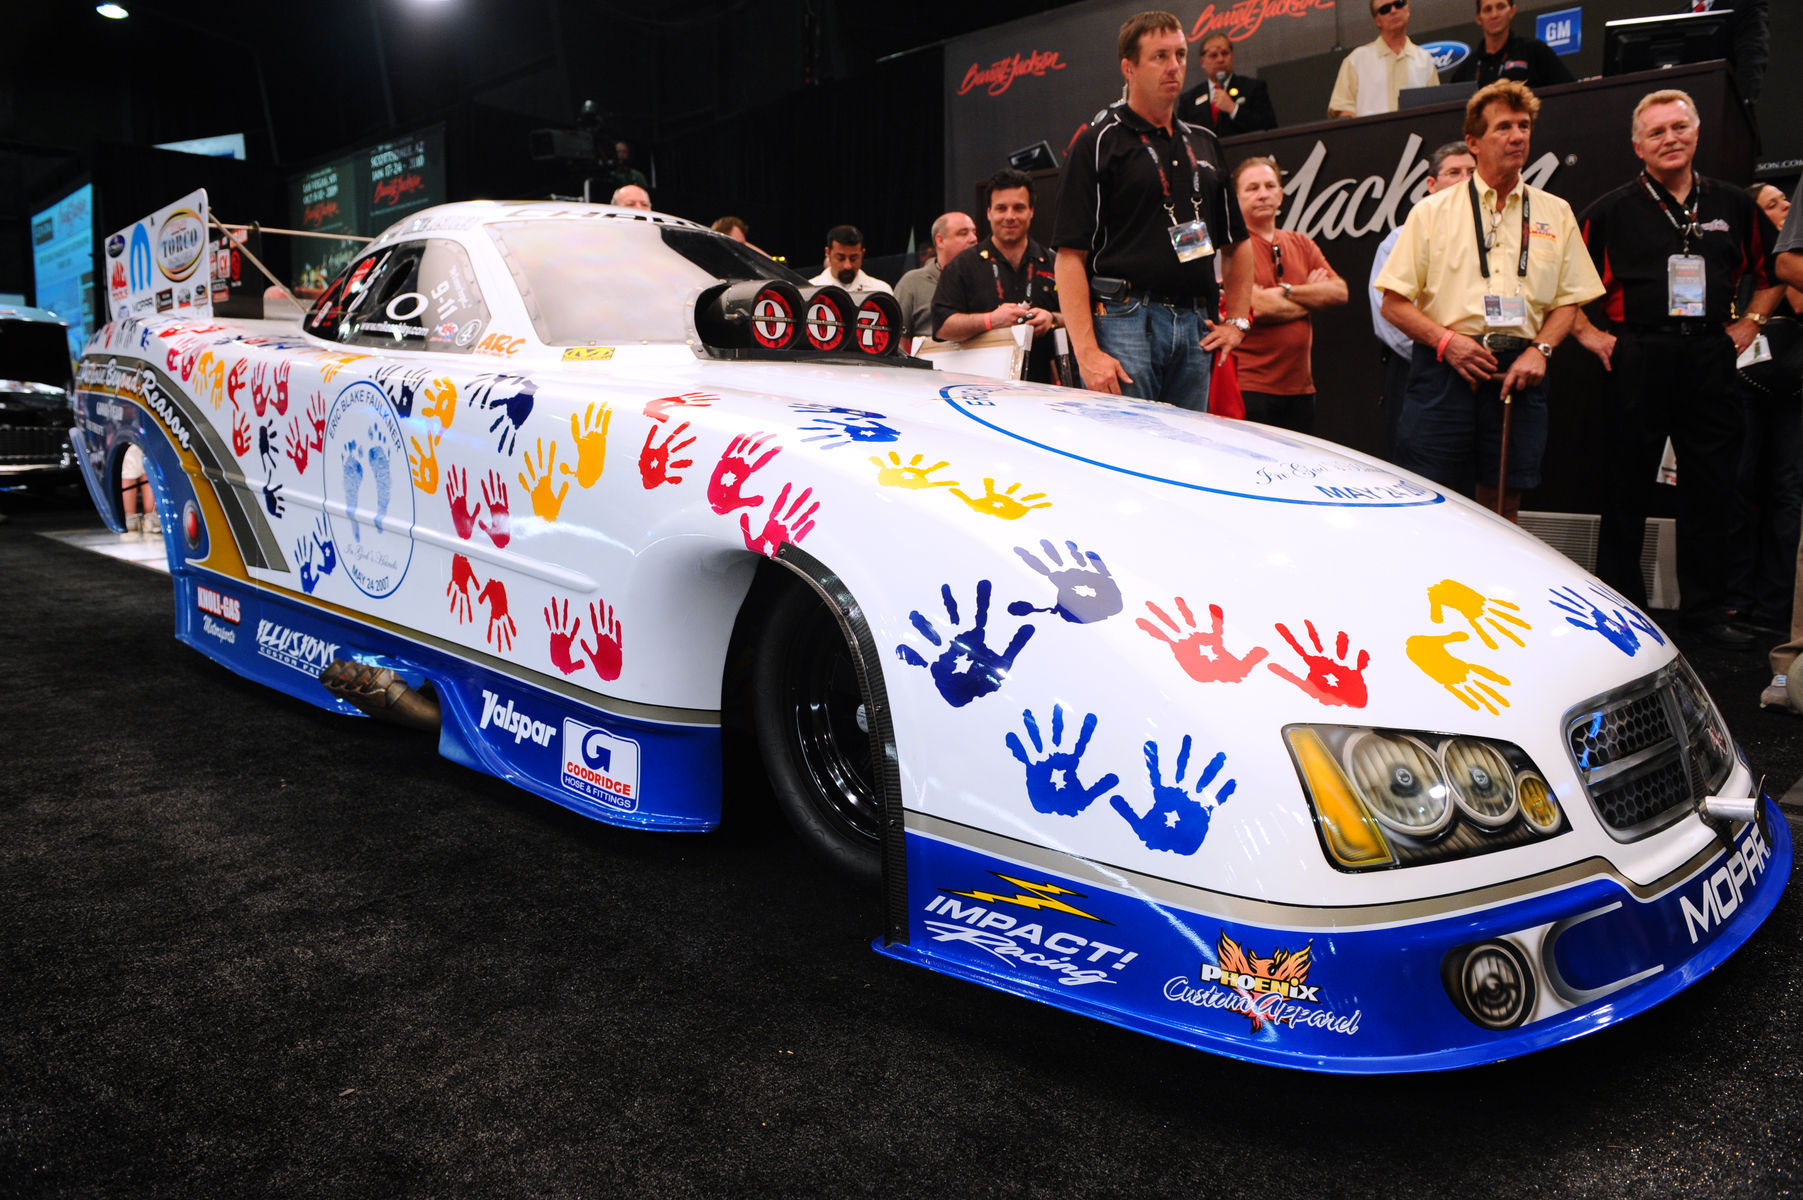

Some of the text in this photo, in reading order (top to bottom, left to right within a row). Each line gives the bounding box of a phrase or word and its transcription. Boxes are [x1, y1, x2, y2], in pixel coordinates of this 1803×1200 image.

[1545, 19, 1571, 40] GM
[956, 49, 1067, 96] Barrett-Jackson
[161, 227, 198, 259] TORCO
[139, 369, 190, 449] Reason
[328, 389, 402, 452] ERIC BLAKE FAULKNER
[1314, 484, 1381, 499] MAY
[351, 563, 390, 592] MAY 24 2007
[197, 586, 241, 625] KNOLL-GAS
[260, 646, 298, 667] CUSTOM
[479, 689, 557, 748] Valspar
[565, 775, 585, 791] HOSE
[592, 787, 631, 809] FITTINGS
[567, 761, 631, 796] GOODRIDGE
[1679, 821, 1772, 945] MOPAR
[924, 895, 1138, 970] IMPACT!
[924, 920, 1117, 986] Racing
[1163, 975, 1362, 1035] Custom Apparel
